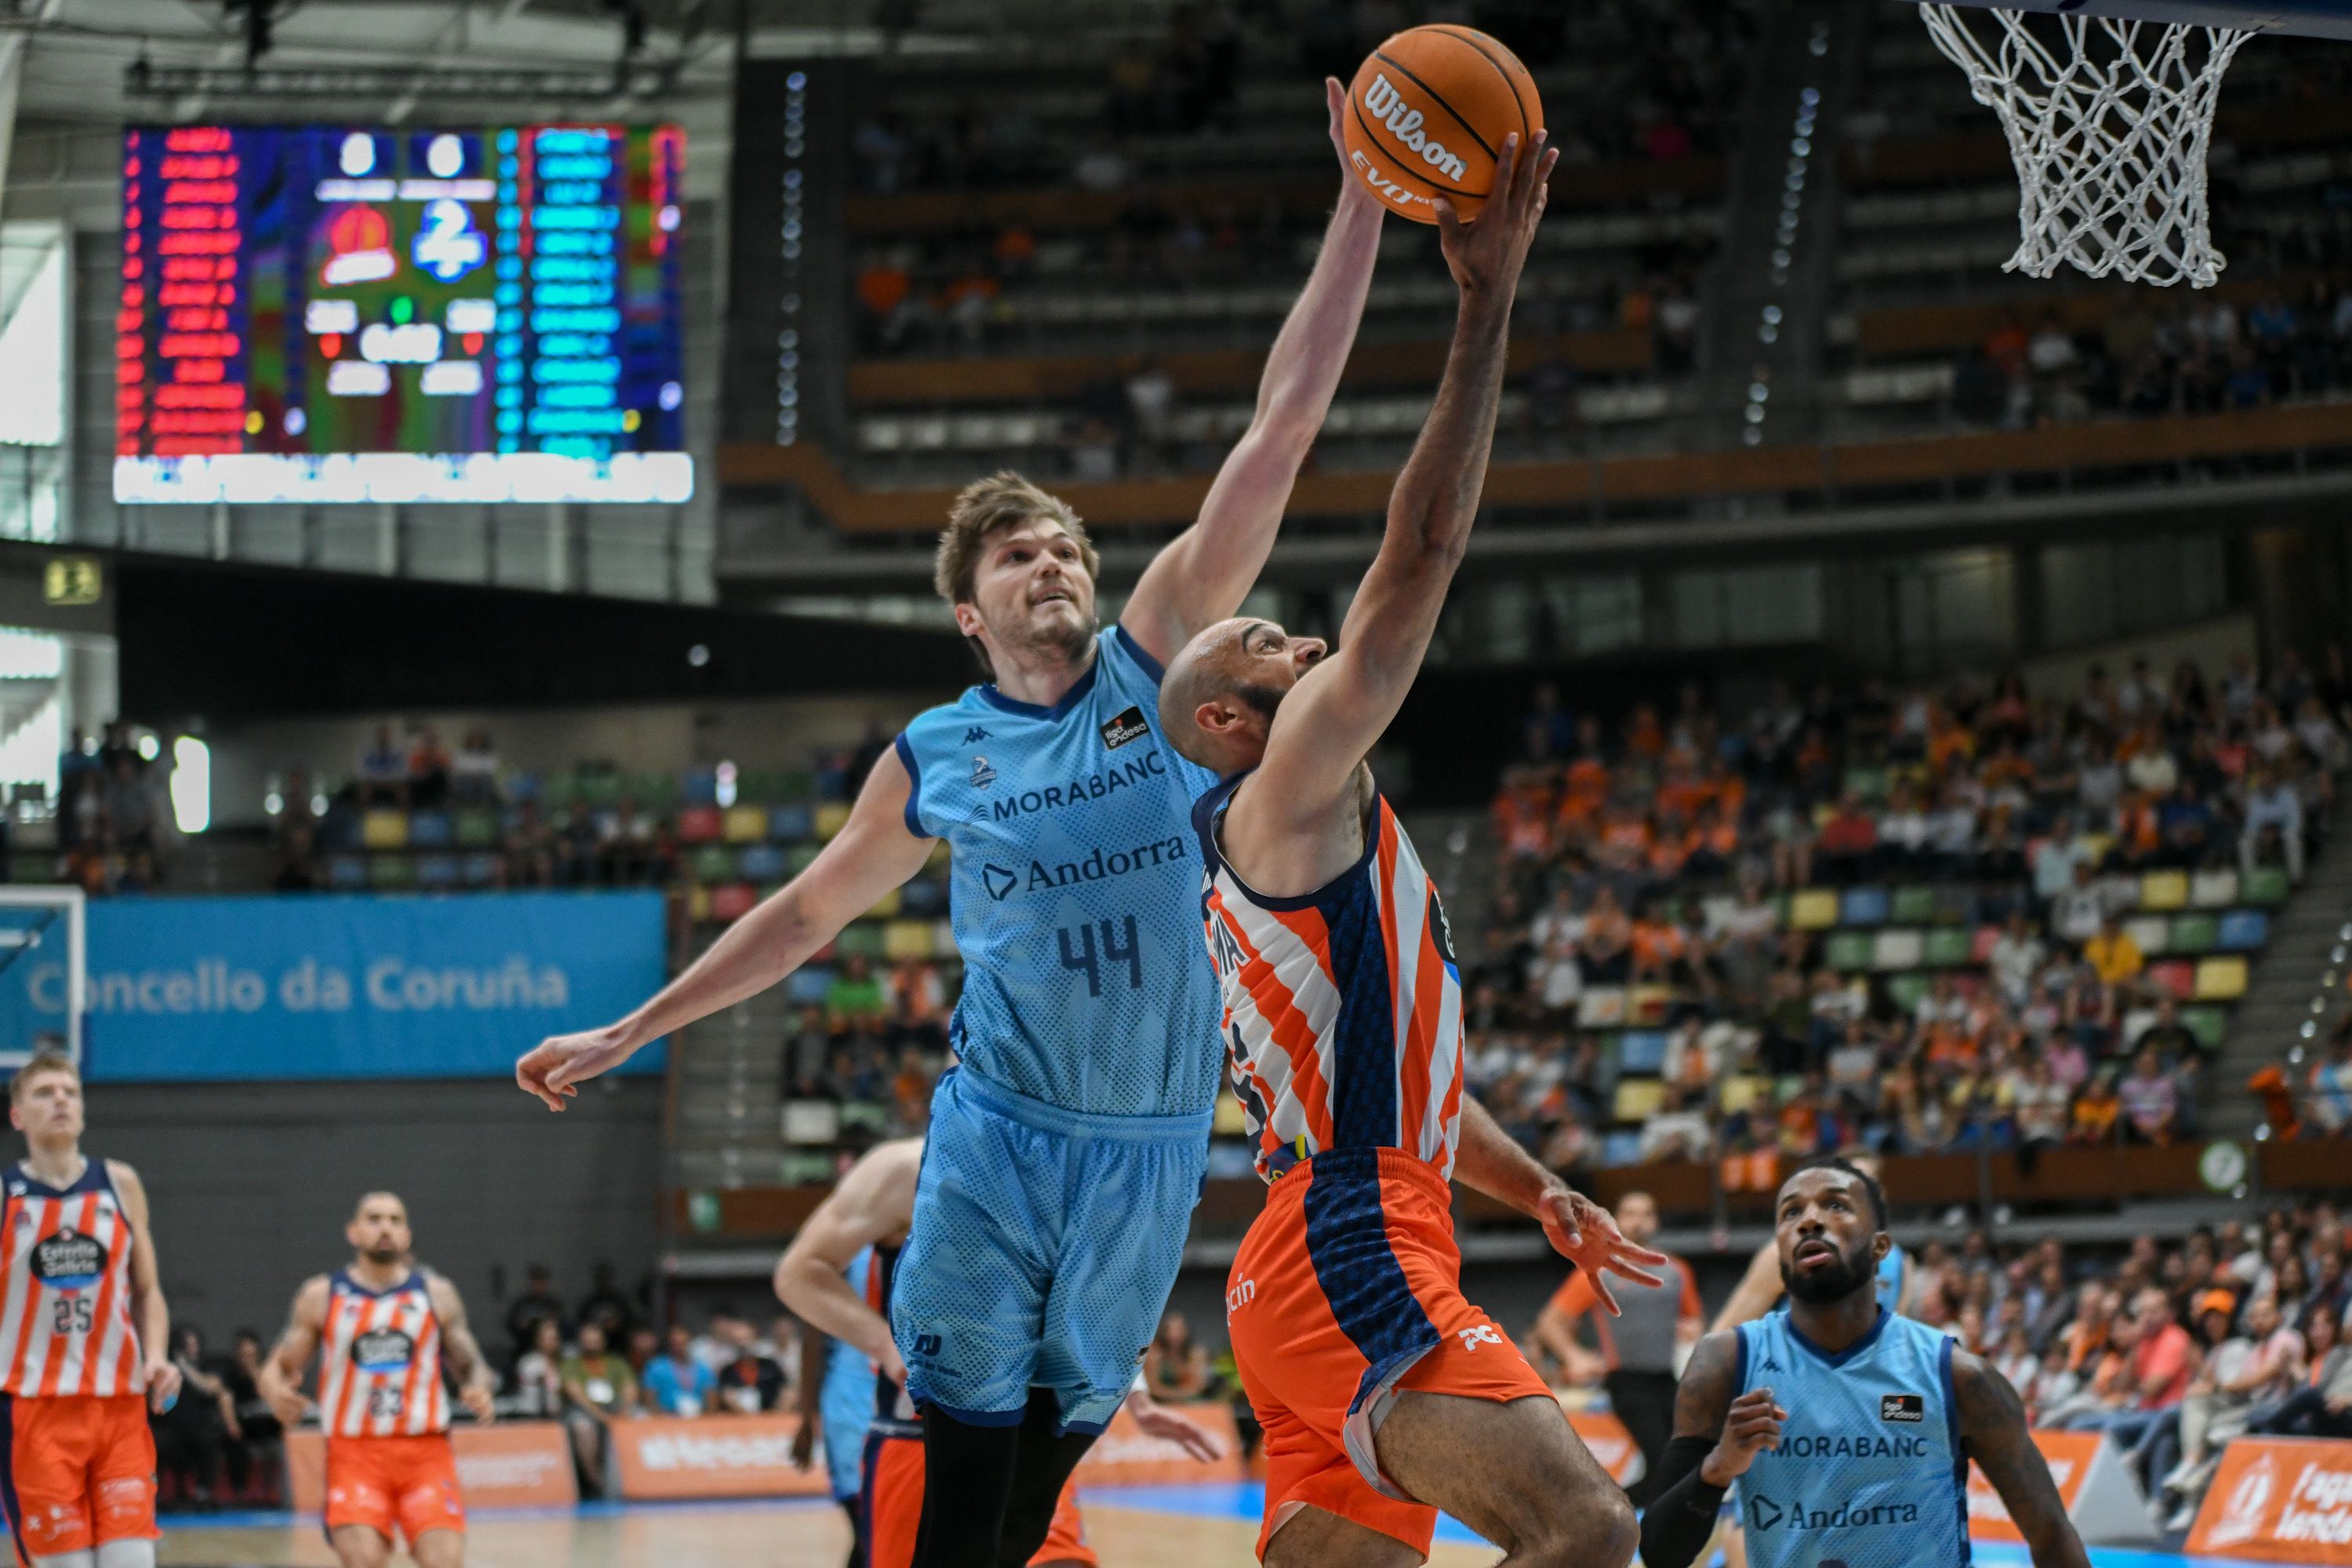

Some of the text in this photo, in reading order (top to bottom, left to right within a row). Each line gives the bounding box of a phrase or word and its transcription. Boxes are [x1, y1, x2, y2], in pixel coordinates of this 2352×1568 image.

[1364, 74, 1468, 183] Wilson
[1105, 726, 1124, 739] liga
[993, 750, 1167, 822] MORABANC
[1026, 836, 1186, 892] Andorra
[281, 954, 351, 1011] da
[366, 953, 568, 1011] Coruña
[1057, 915, 1142, 998] 44
[53, 1298, 92, 1334] 25
[1771, 1436, 1927, 1458] MORABANC
[1788, 1502, 1918, 1530] Andorra
